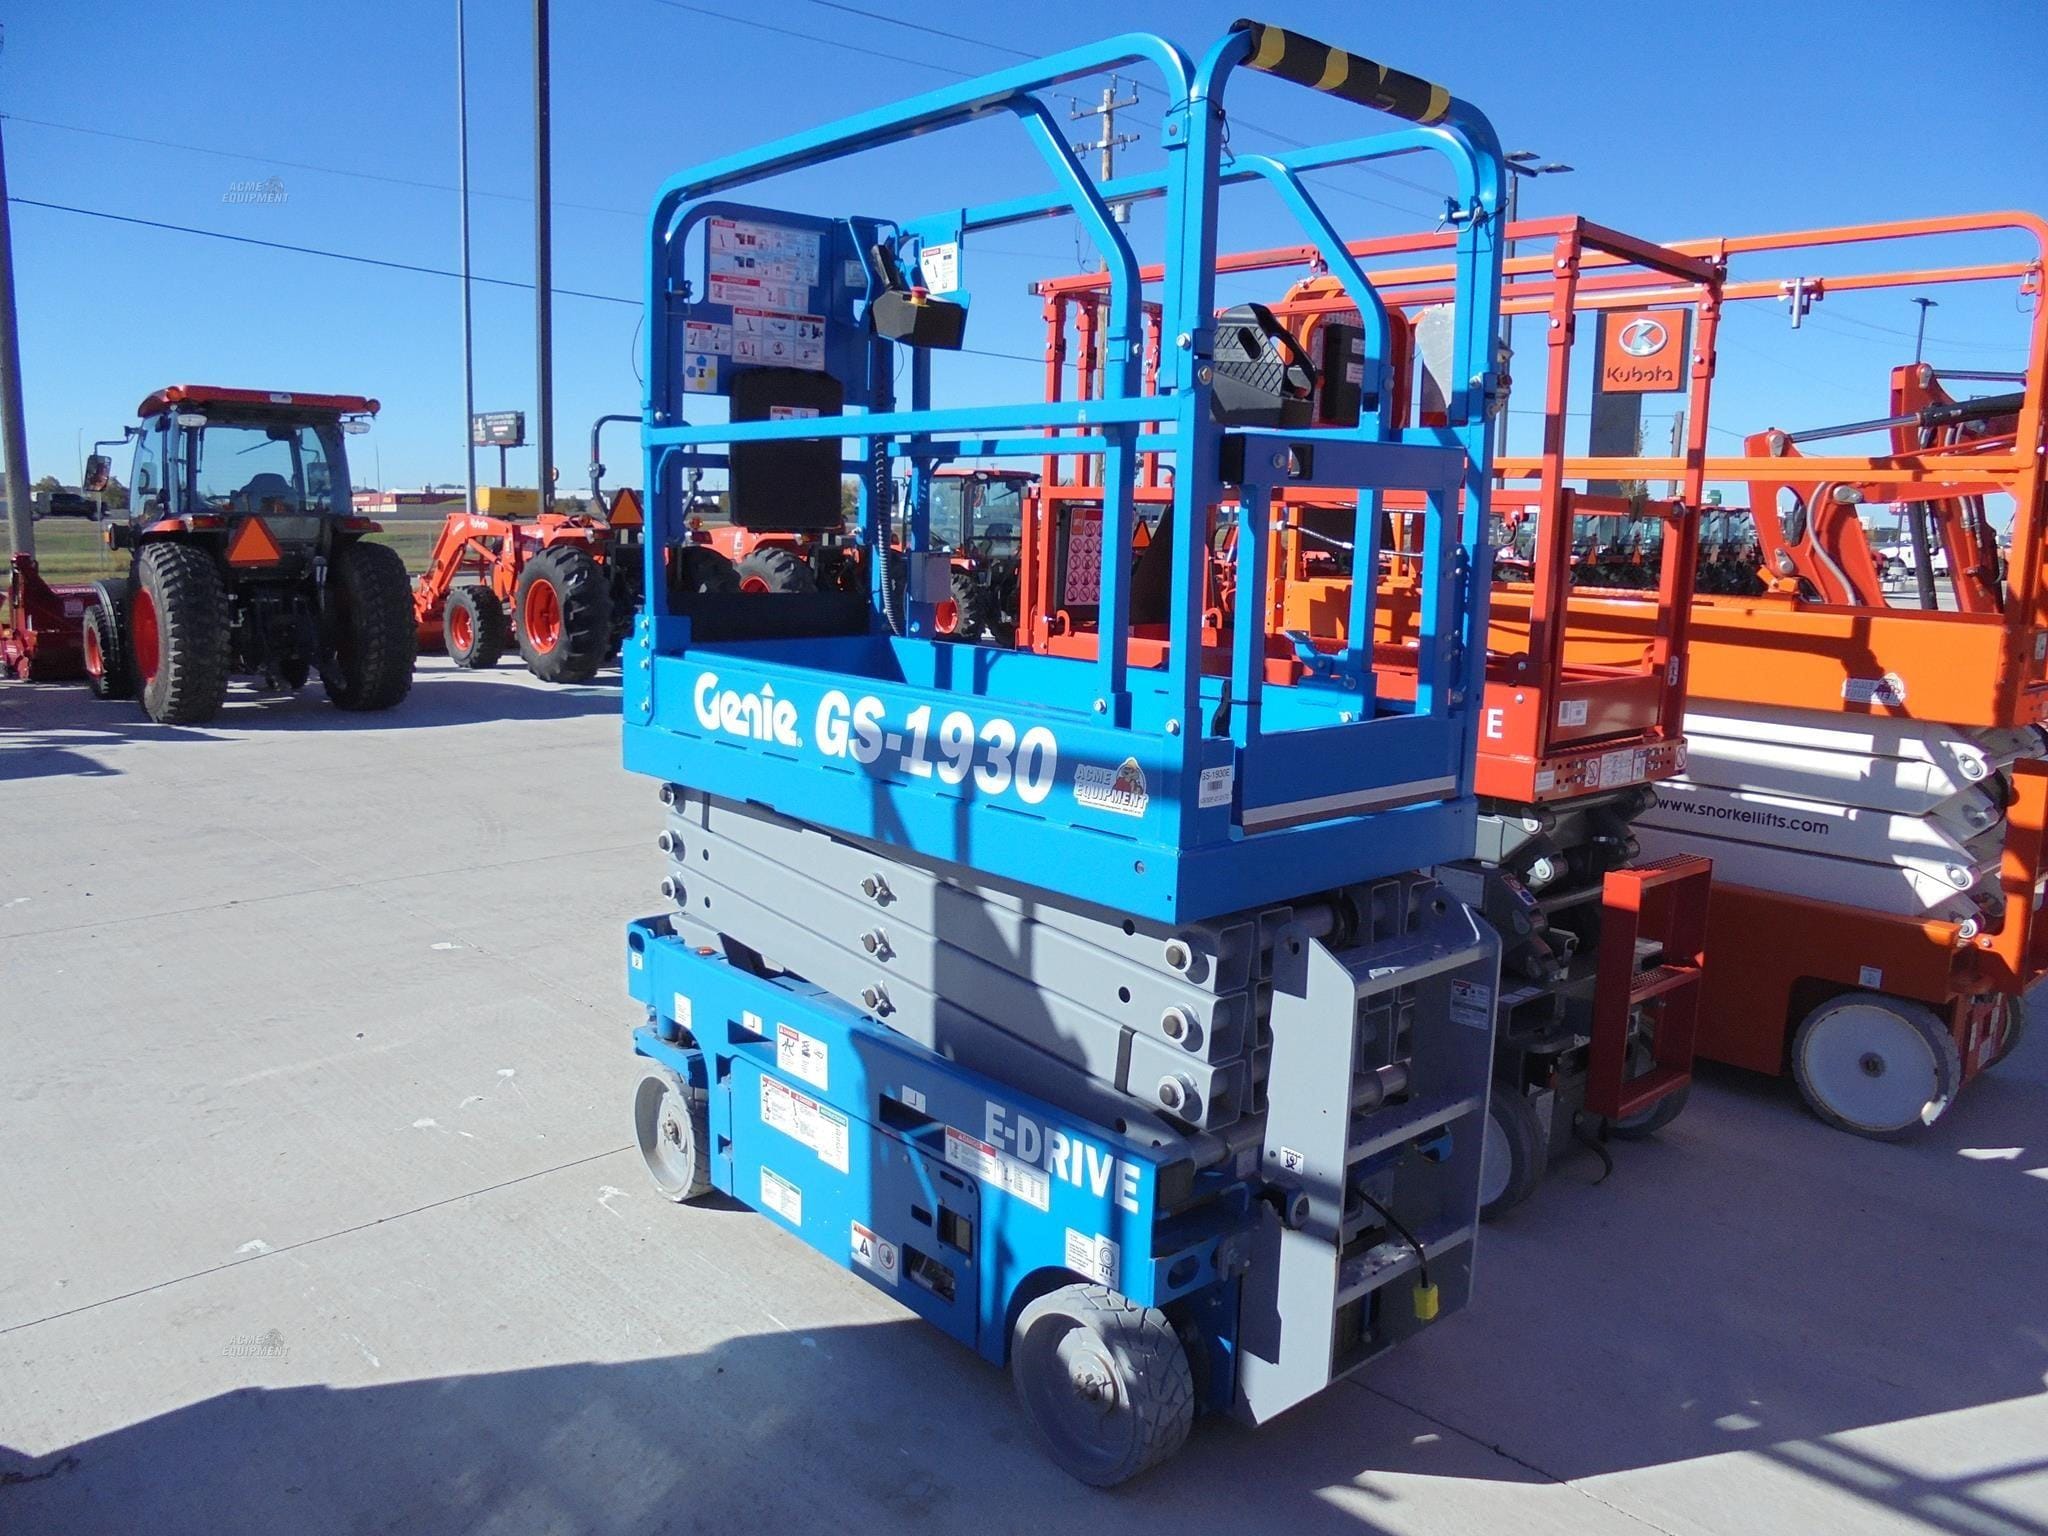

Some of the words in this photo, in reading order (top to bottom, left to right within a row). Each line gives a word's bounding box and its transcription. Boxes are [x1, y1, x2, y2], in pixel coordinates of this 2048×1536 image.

[1606, 366, 1673, 383] Kubota
[694, 672, 798, 747] Genie
[815, 690, 1057, 804] GS-1930
[1077, 765, 1112, 786] ACME
[1076, 783, 1146, 809] EQUIPMENT
[1658, 799, 1829, 835] www.snorkellifts.com
[985, 1100, 1141, 1215] E-DRIVE
